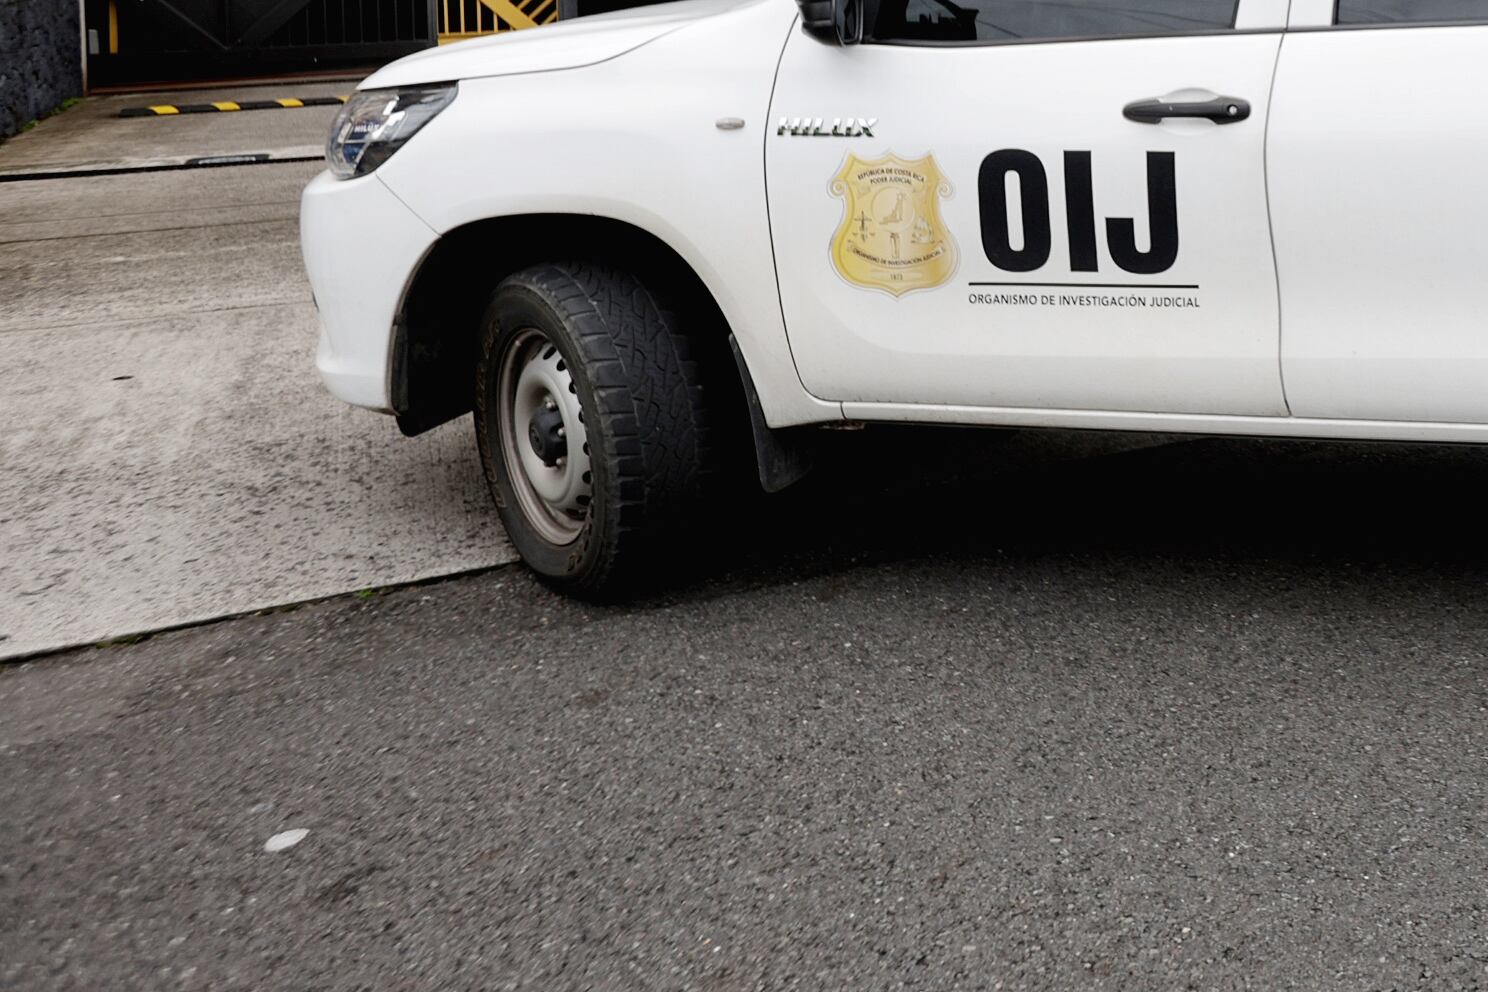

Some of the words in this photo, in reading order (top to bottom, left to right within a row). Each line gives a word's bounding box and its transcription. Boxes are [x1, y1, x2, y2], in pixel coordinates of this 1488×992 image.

[777, 117, 878, 137] HILUX
[976, 147, 1180, 276] OIJ
[968, 294, 1038, 306] ORGANISMO
[1040, 295, 1055, 306] DE
[1059, 293, 1146, 308] INVESTIGACIÓN
[1150, 296, 1200, 308] JUDICIAL
